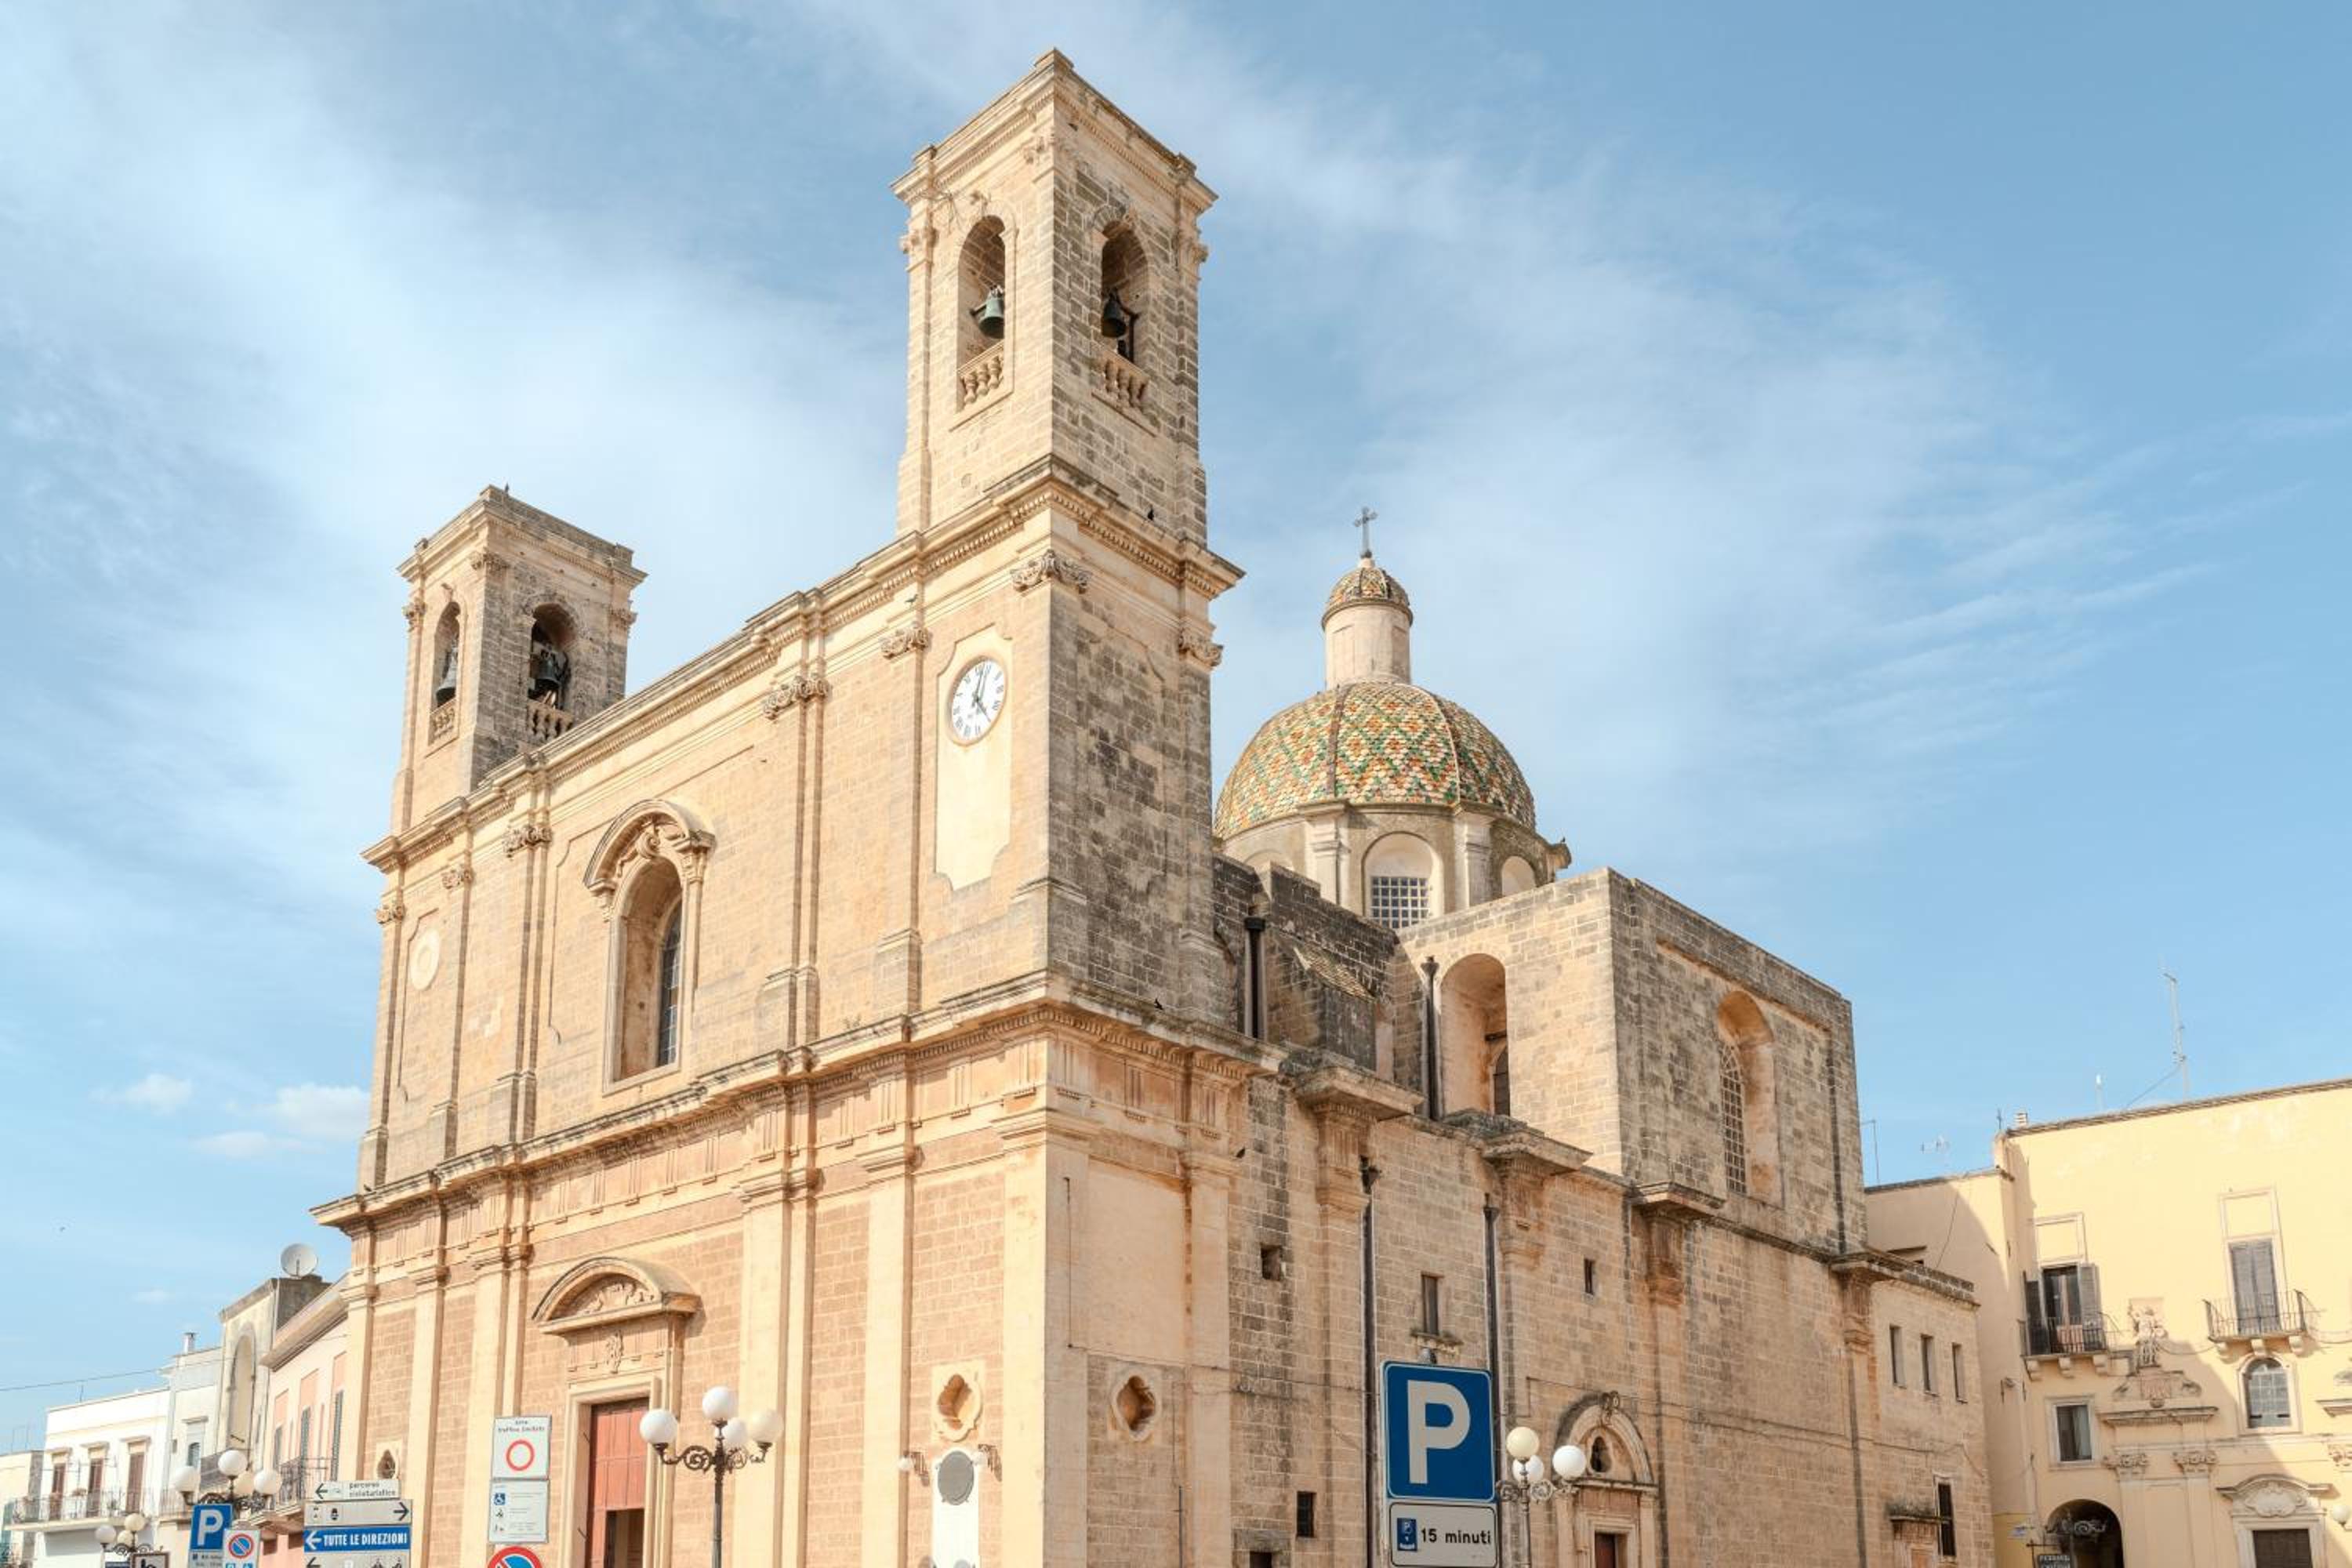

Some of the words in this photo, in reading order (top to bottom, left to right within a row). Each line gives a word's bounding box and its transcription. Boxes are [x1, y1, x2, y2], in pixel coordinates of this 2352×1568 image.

[1407, 1380, 1471, 1484] P
[197, 1509, 223, 1546] P
[323, 1534, 347, 1546] TUTTE
[350, 1534, 361, 1545] LE
[361, 1533, 408, 1545] DIREZIONI
[1421, 1528, 1437, 1543] 15
[1445, 1530, 1491, 1544] minuti
